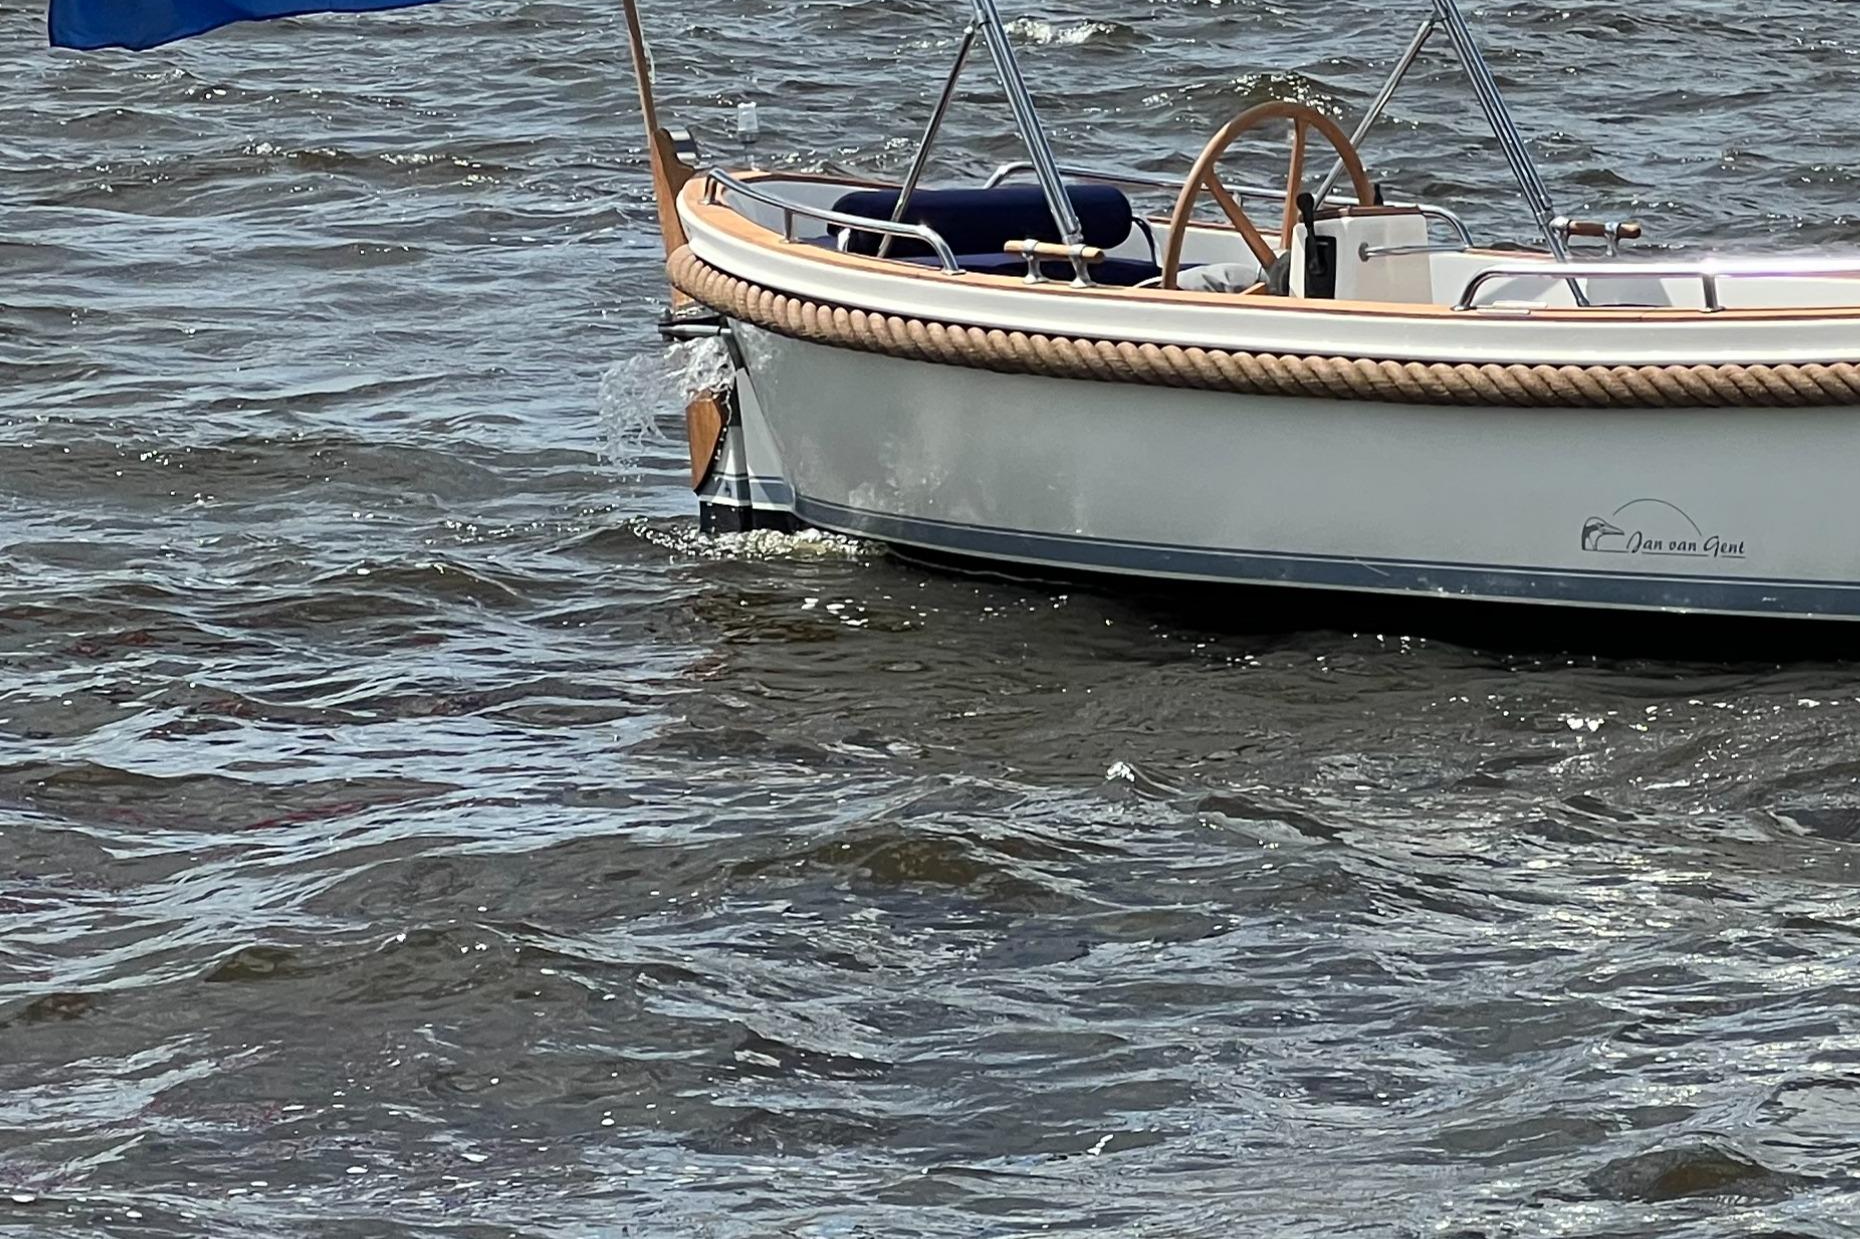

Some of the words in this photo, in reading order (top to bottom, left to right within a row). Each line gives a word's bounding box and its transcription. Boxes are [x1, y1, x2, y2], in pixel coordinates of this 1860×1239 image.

[1626, 530, 1663, 554] Jan
[1669, 539, 1697, 553] van
[1703, 535, 1746, 558] Gent
